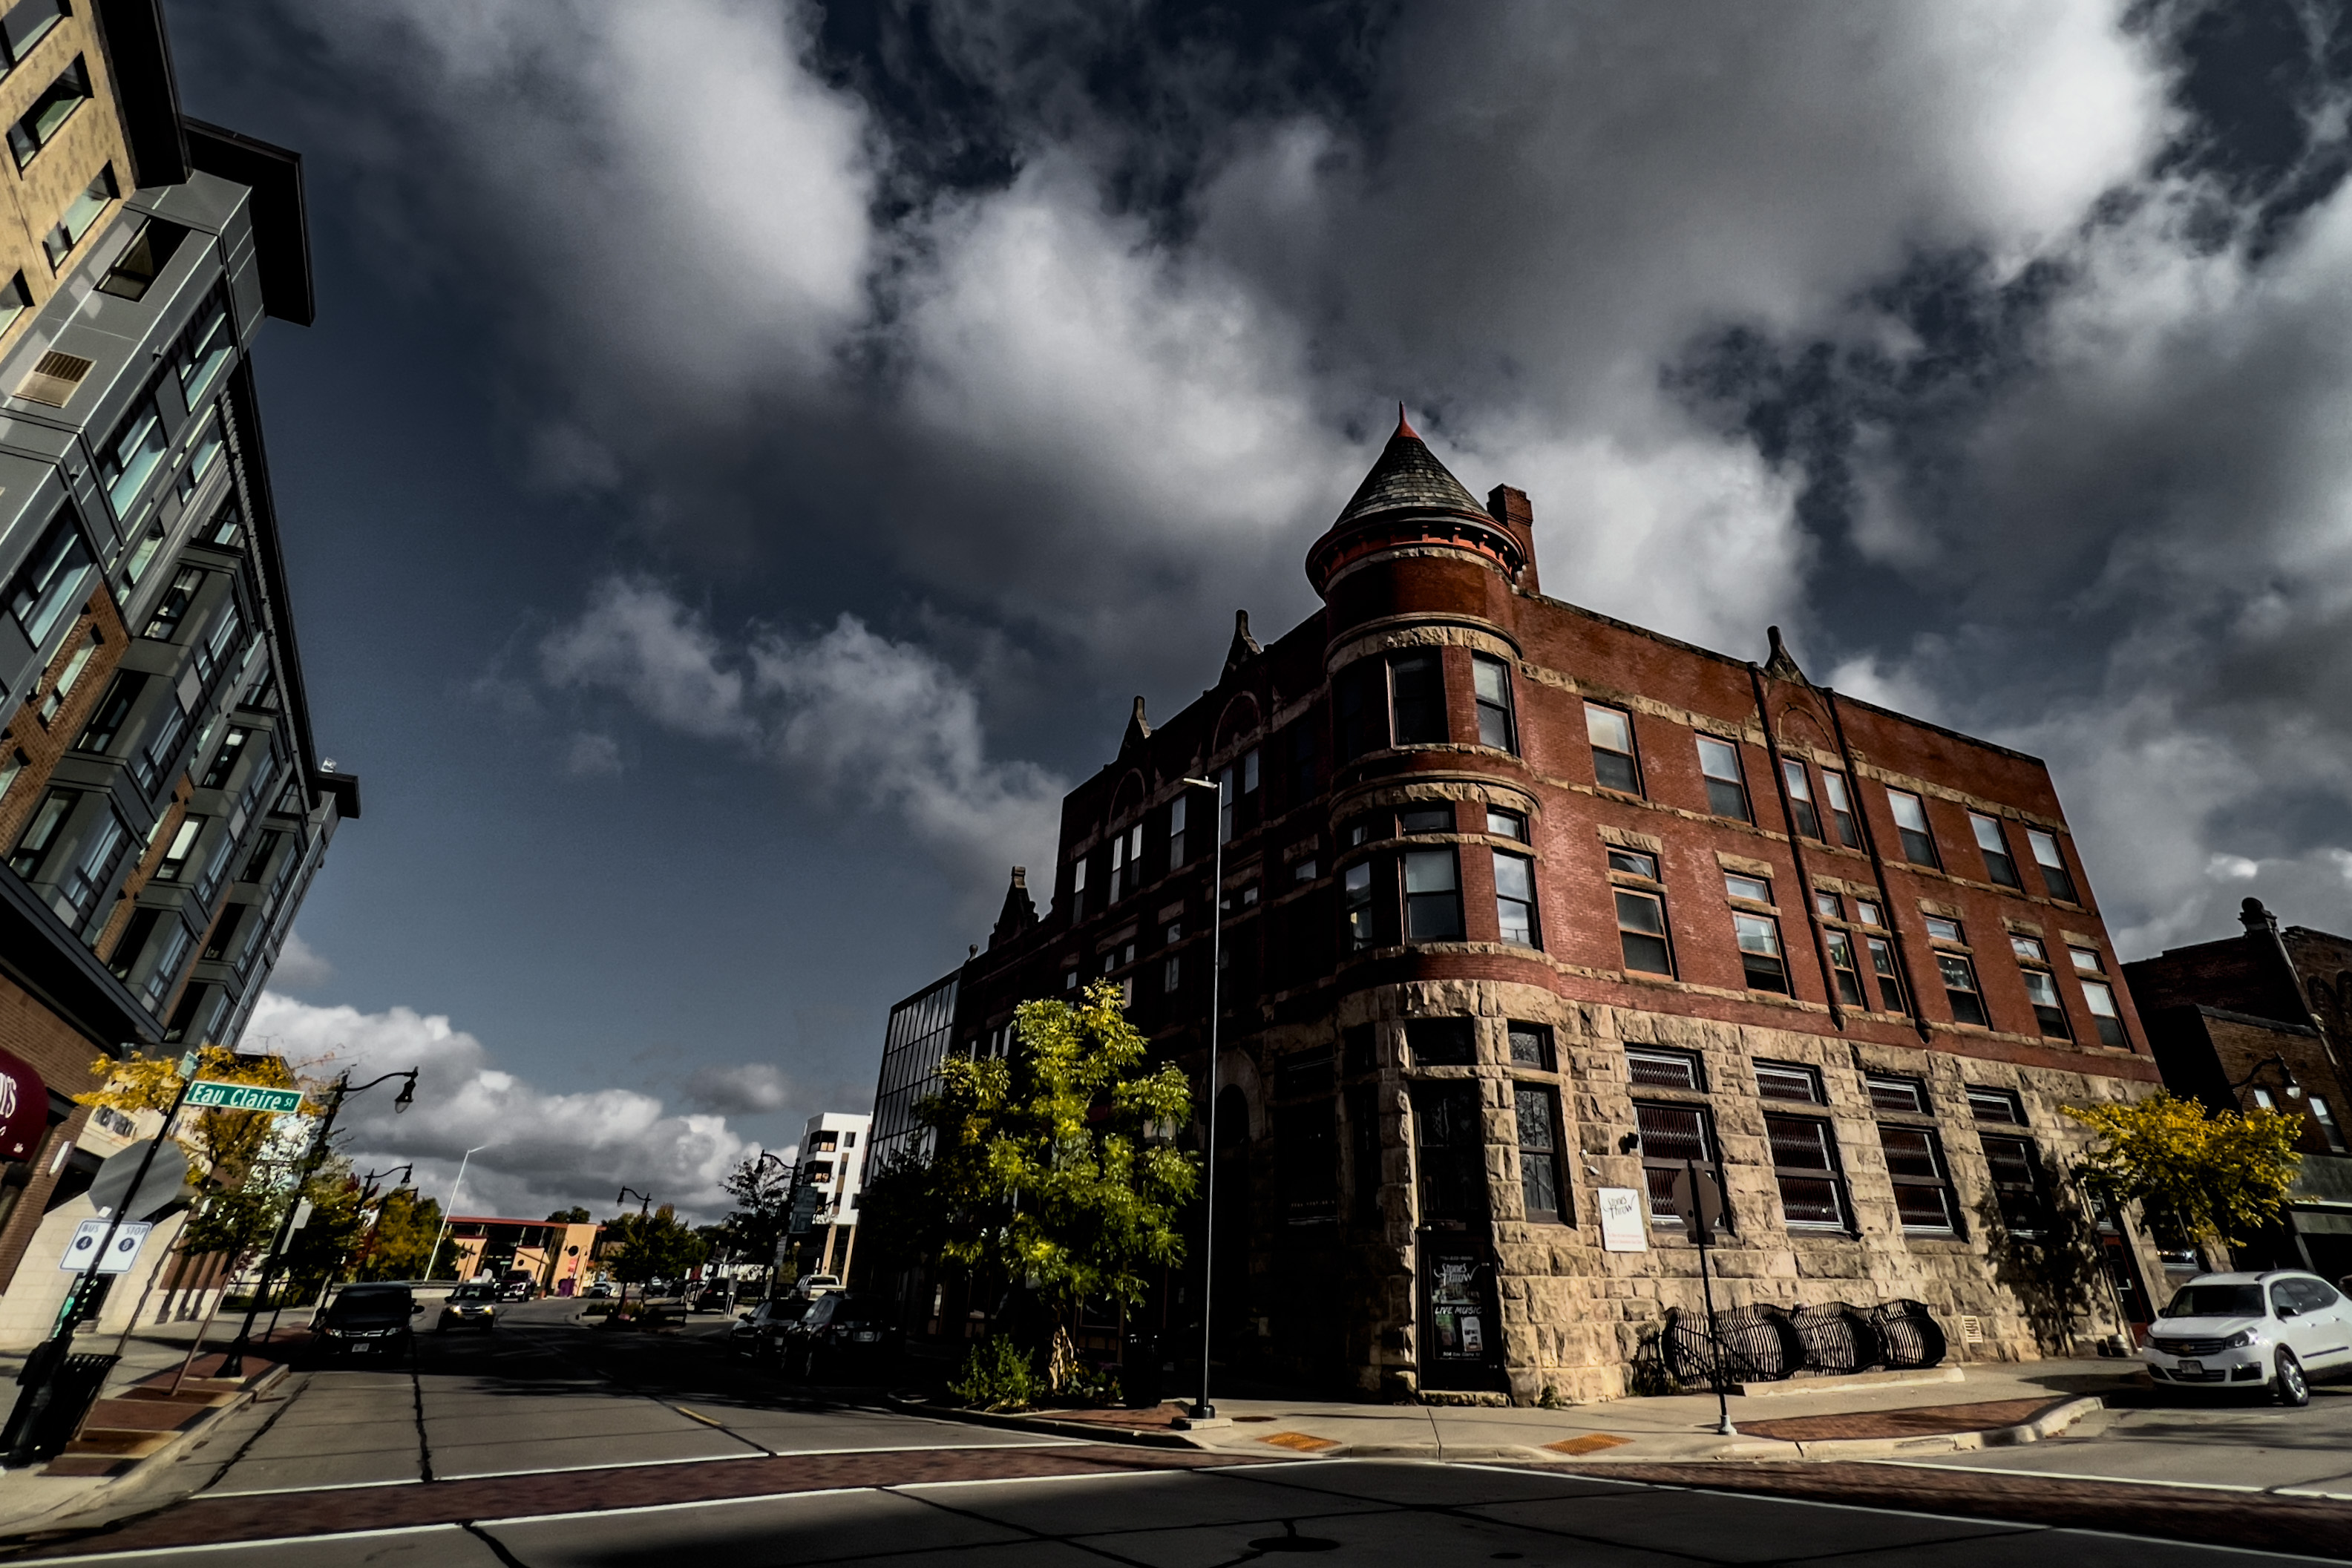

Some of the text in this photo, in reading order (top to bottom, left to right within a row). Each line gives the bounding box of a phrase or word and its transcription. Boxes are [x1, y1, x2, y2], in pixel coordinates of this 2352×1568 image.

[191, 1085, 294, 1109] Eau Claire St
[82, 1224, 148, 1236] BUS STOP
[1435, 1306, 1482, 1315] LIVE MUSIC
